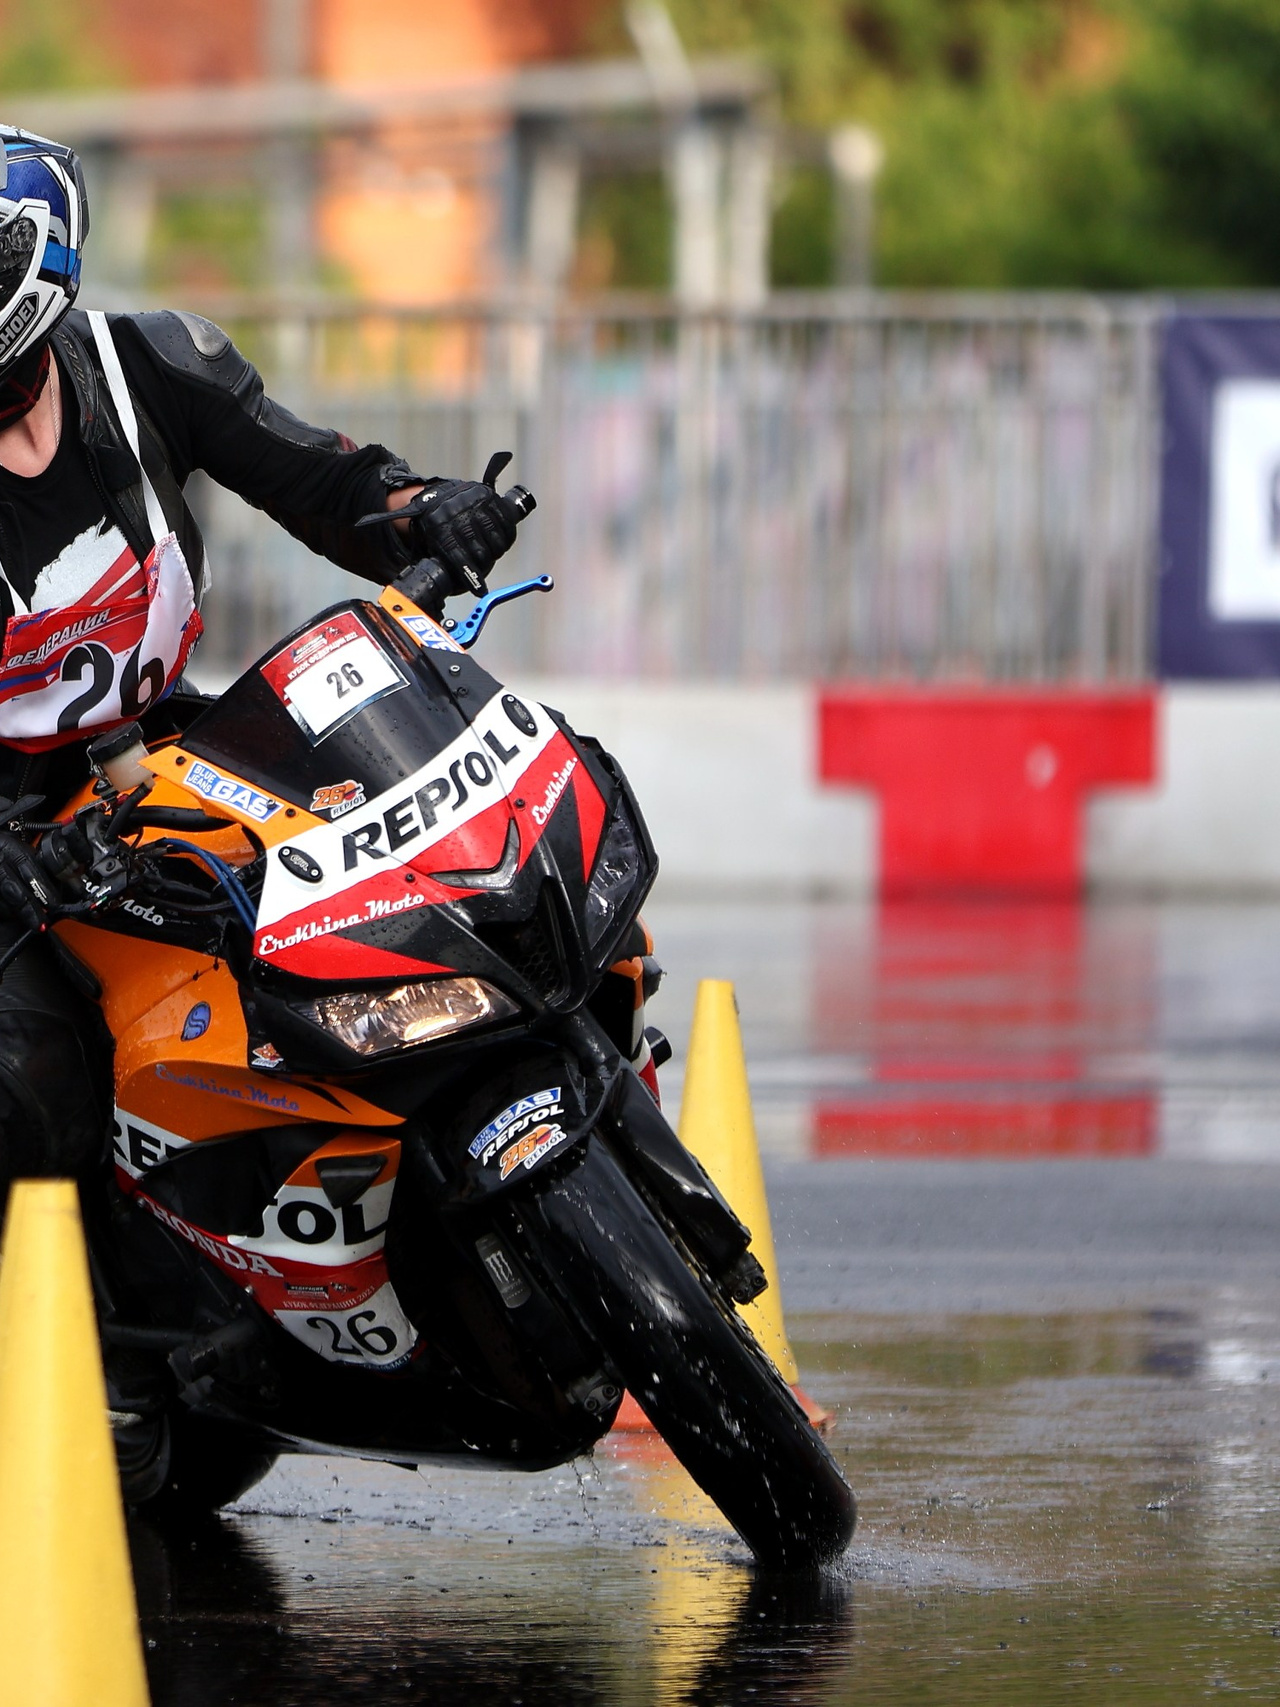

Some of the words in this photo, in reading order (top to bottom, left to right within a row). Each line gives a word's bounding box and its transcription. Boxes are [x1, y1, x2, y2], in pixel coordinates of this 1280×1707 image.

[6, 608, 110, 669] ФЕДЕРАЦИЯ
[56, 636, 165, 734] 26
[326, 663, 364, 699] 26
[189, 774, 213, 793] JEANS
[194, 765, 217, 783] BLUE
[211, 779, 269, 818] GAS
[312, 785, 347, 809] 26
[333, 795, 365, 816] REPSOL
[343, 729, 521, 872] REPSOL
[494, 1091, 554, 1130] GAS
[483, 1104, 564, 1167] REPSOL
[501, 1133, 538, 1177] 26
[527, 1134, 562, 1166] REPSOL
[149, 1205, 284, 1278] HONDA
[306, 1310, 398, 1357] 26
